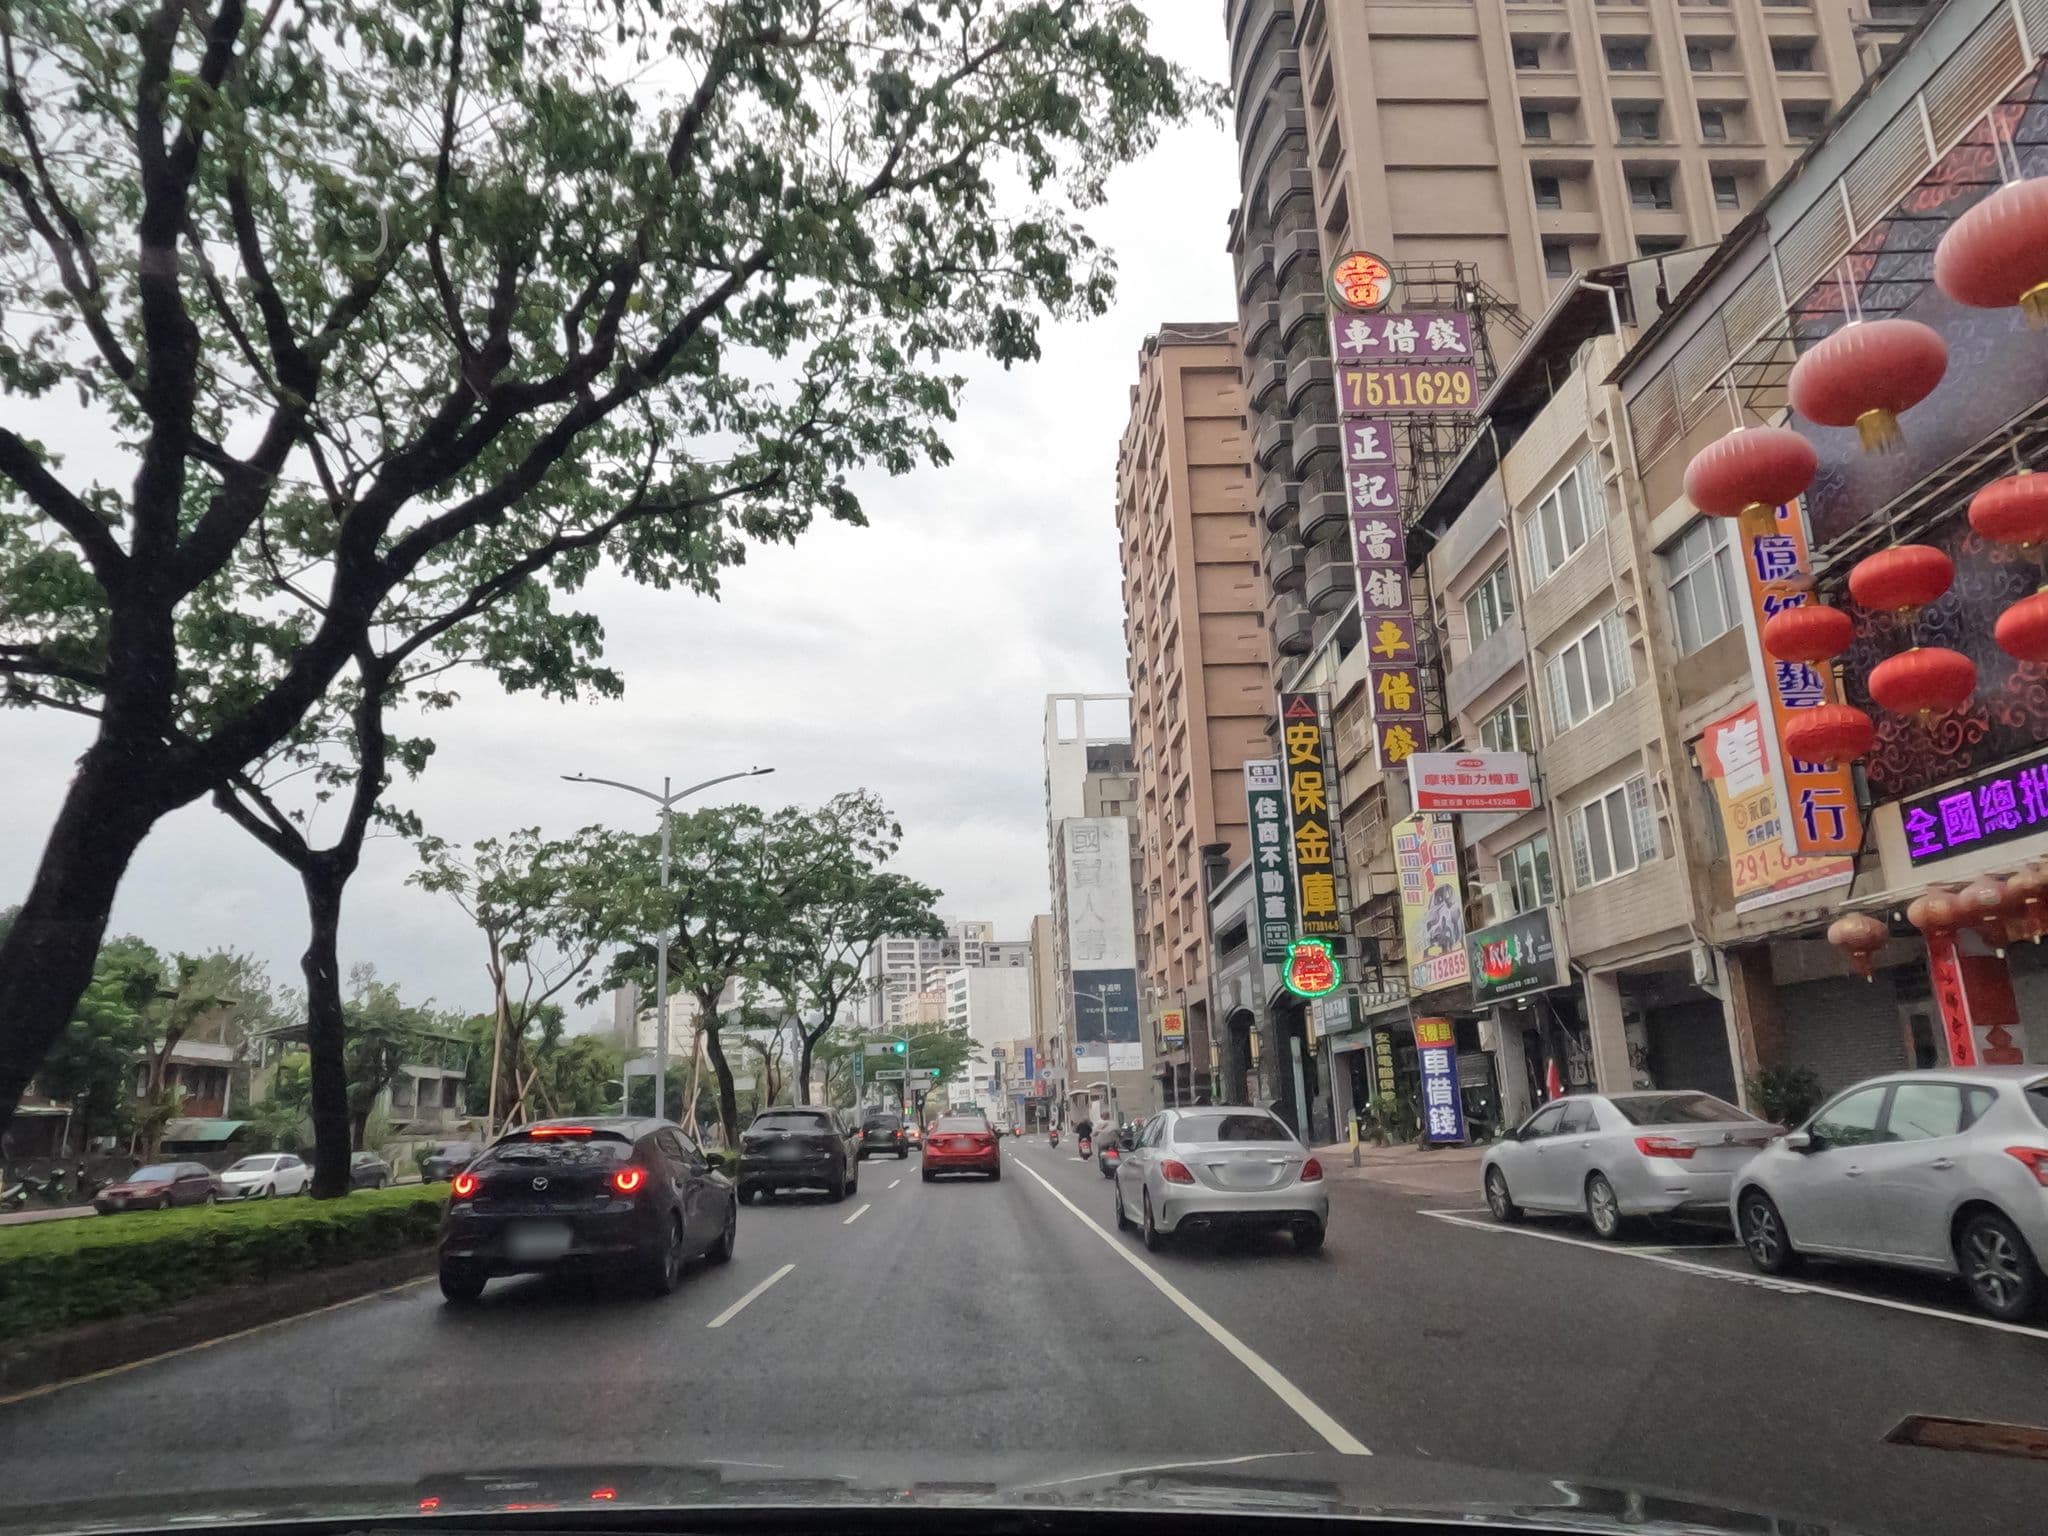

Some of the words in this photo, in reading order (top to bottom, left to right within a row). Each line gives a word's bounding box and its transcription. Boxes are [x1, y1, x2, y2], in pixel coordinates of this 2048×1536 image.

[1335, 254, 1388, 307] 當
[1341, 318, 1467, 354] 車借錢
[1346, 371, 1471, 406] 7511629
[1372, 620, 1419, 764] 車借錢
[1424, 772, 1520, 786] 摩特動力機車
[1286, 723, 1337, 917] 安保金庫
[1255, 796, 1287, 919] 住商不動產
[1423, 1048, 1458, 1136] 車借錢
